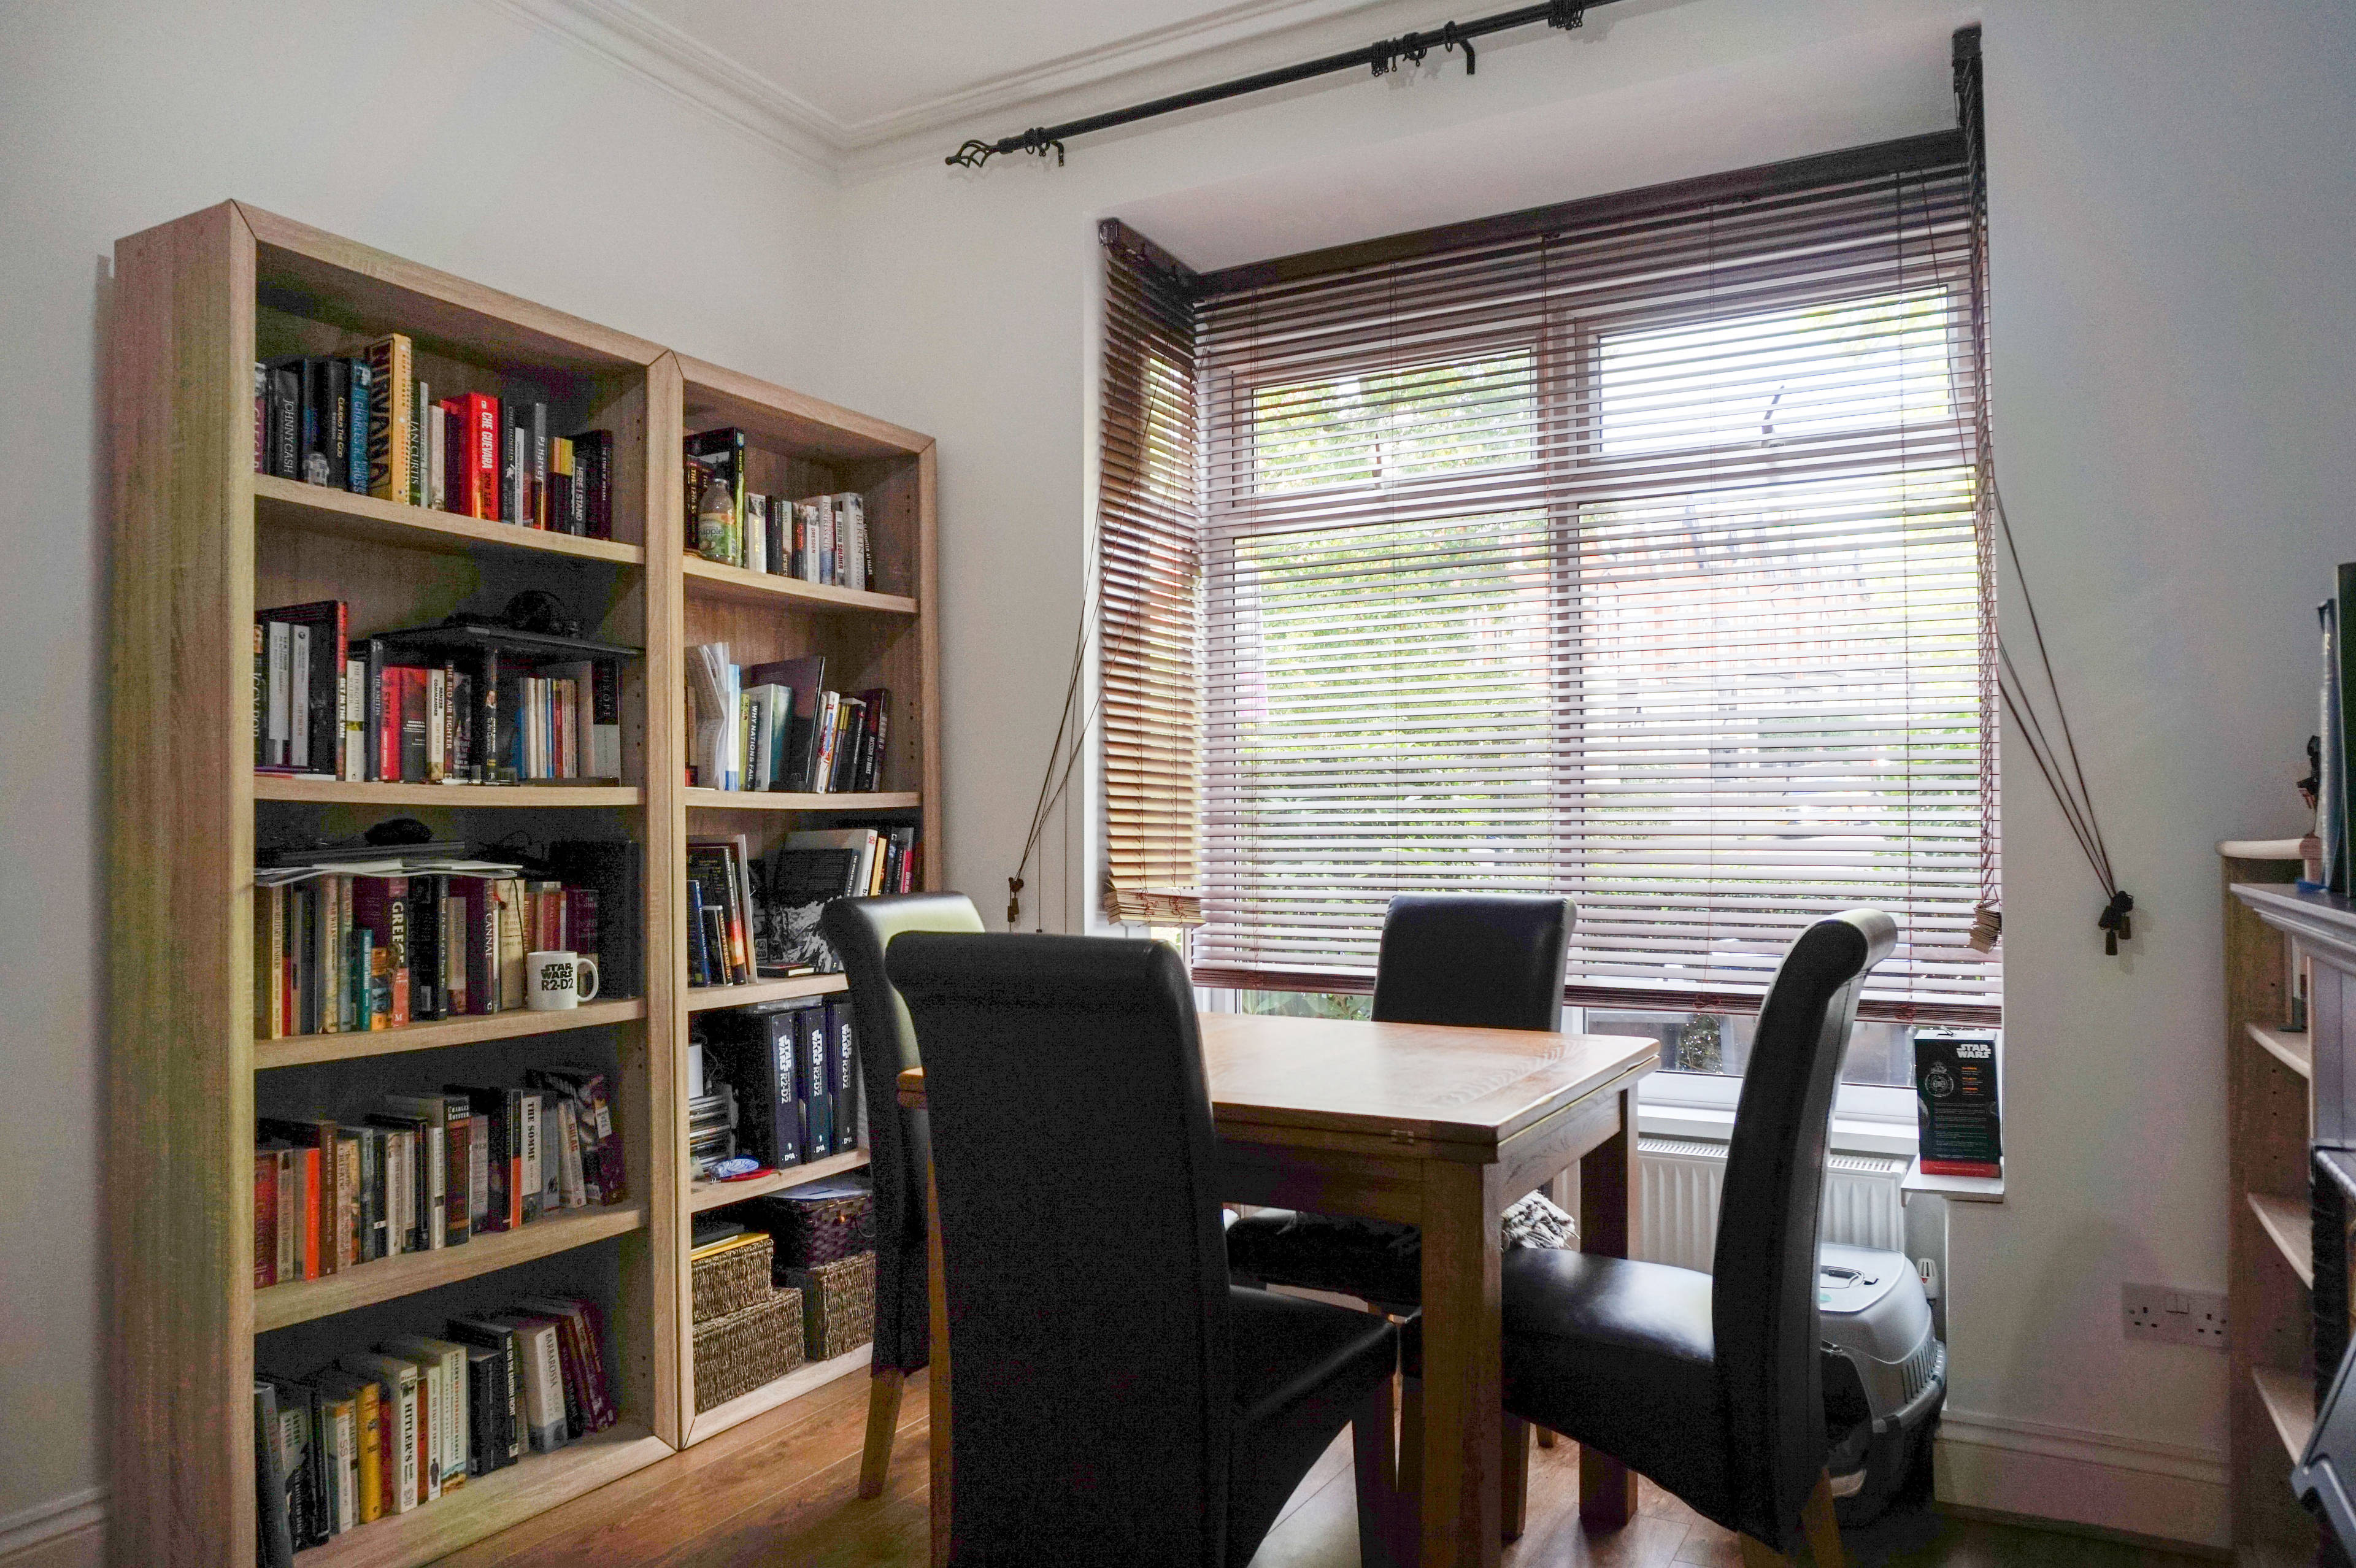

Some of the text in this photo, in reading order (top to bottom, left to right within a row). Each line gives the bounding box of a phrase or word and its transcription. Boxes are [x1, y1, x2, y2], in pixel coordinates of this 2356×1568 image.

[283, 398, 294, 473] JOHNNY CASH
[353, 401, 364, 444] CHARLES
[369, 345, 391, 485] NIRVANA
[482, 412, 493, 469] CHE GUEVARA
[536, 436, 545, 481] PJ Harvey
[339, 694, 345, 704] IN
[541, 963, 573, 972] STAR
[541, 970, 573, 979] WARS
[722, 935, 731, 979] PETERSBURG
[541, 978, 573, 991] R2-D2
[1956, 1043, 1991, 1052] STAR
[507, 1350, 513, 1361] ON
[545, 1333, 557, 1388] BARBAROSSA
[404, 1403, 413, 1462] HITLER'S
